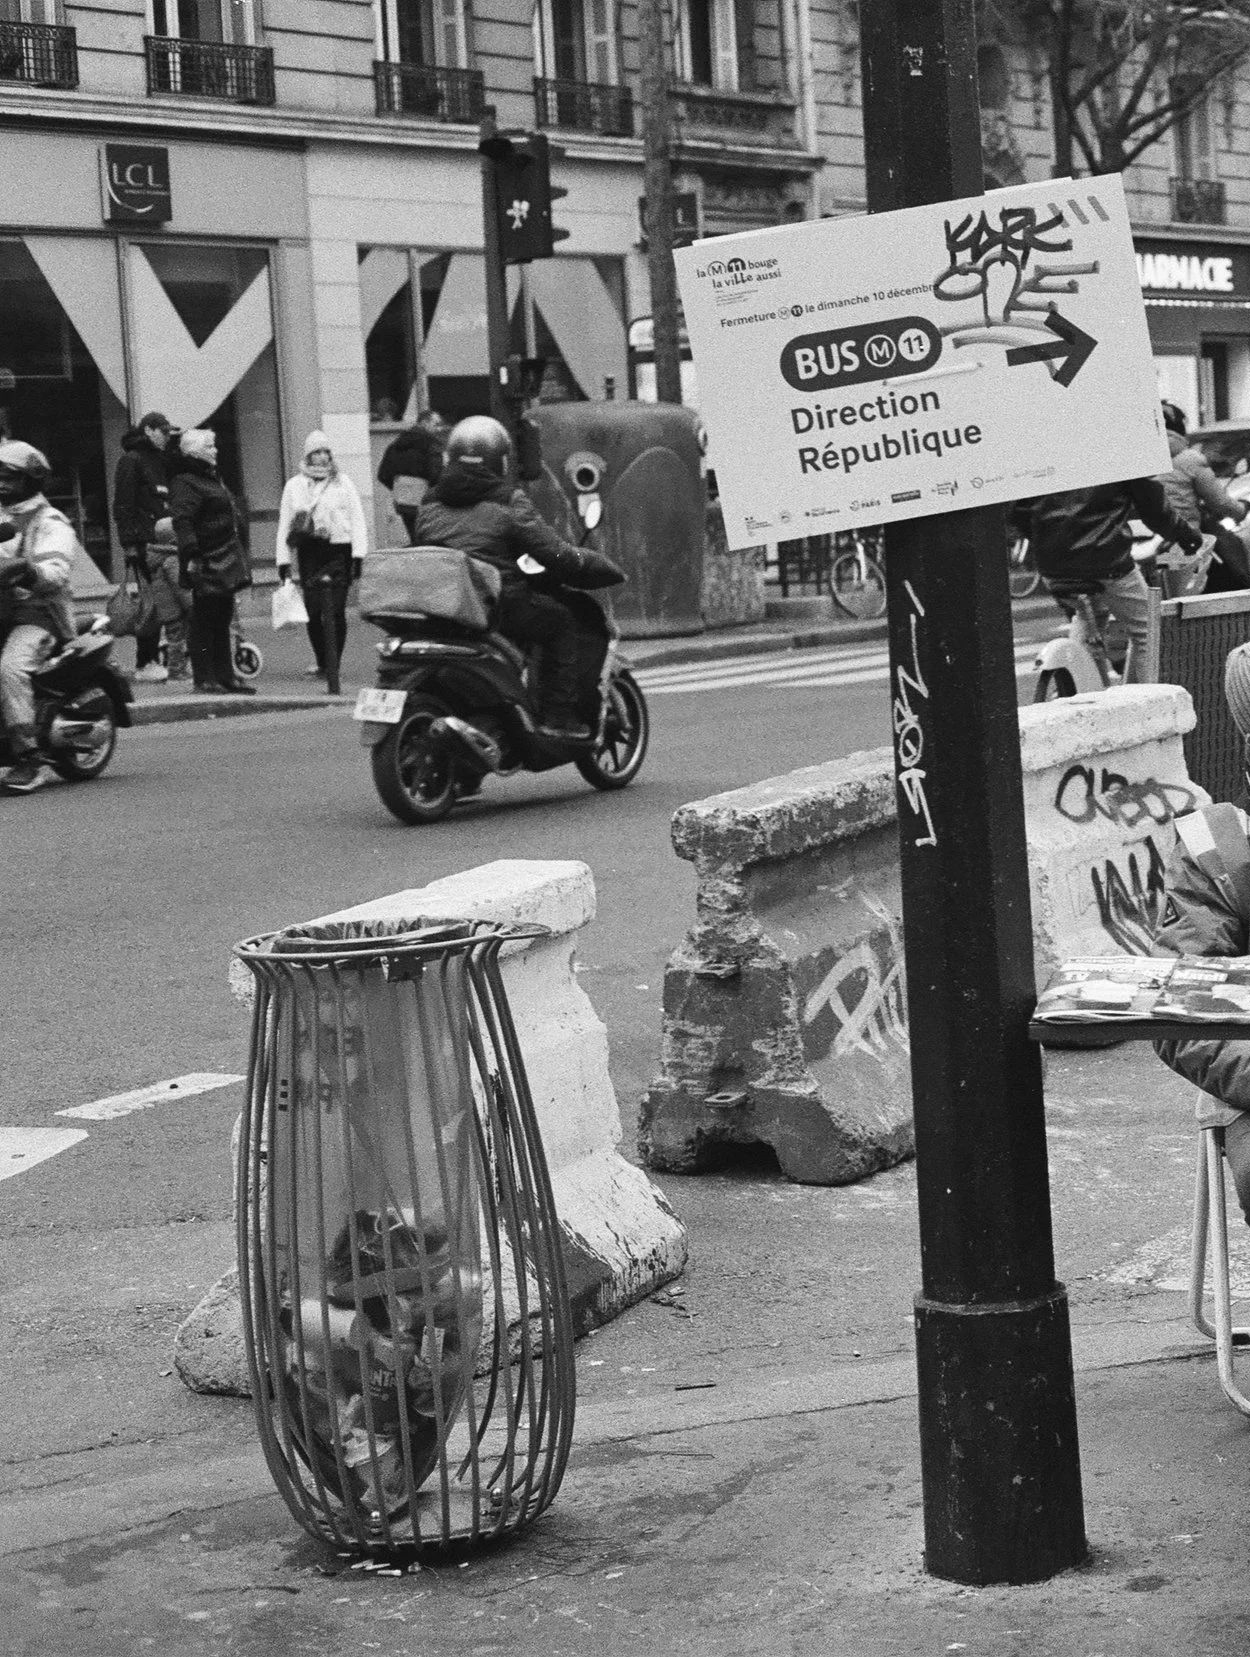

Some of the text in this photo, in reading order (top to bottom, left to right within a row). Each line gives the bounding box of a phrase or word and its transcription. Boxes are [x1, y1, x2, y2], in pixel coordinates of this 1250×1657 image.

[112, 162, 163, 188] LCL
[696, 268, 707, 278] la
[747, 258, 779, 270] bouge
[711, 278, 723, 288] la
[756, 267, 782, 281] aussi
[1135, 252, 1235, 291] ARMACIE
[719, 310, 777, 328] Fermeture
[805, 303, 816, 314] le
[817, 295, 870, 312] dimanche
[872, 291, 886, 302] 10
[794, 340, 860, 380] BUS
[791, 391, 941, 435] Direction
[798, 424, 982, 474] République
